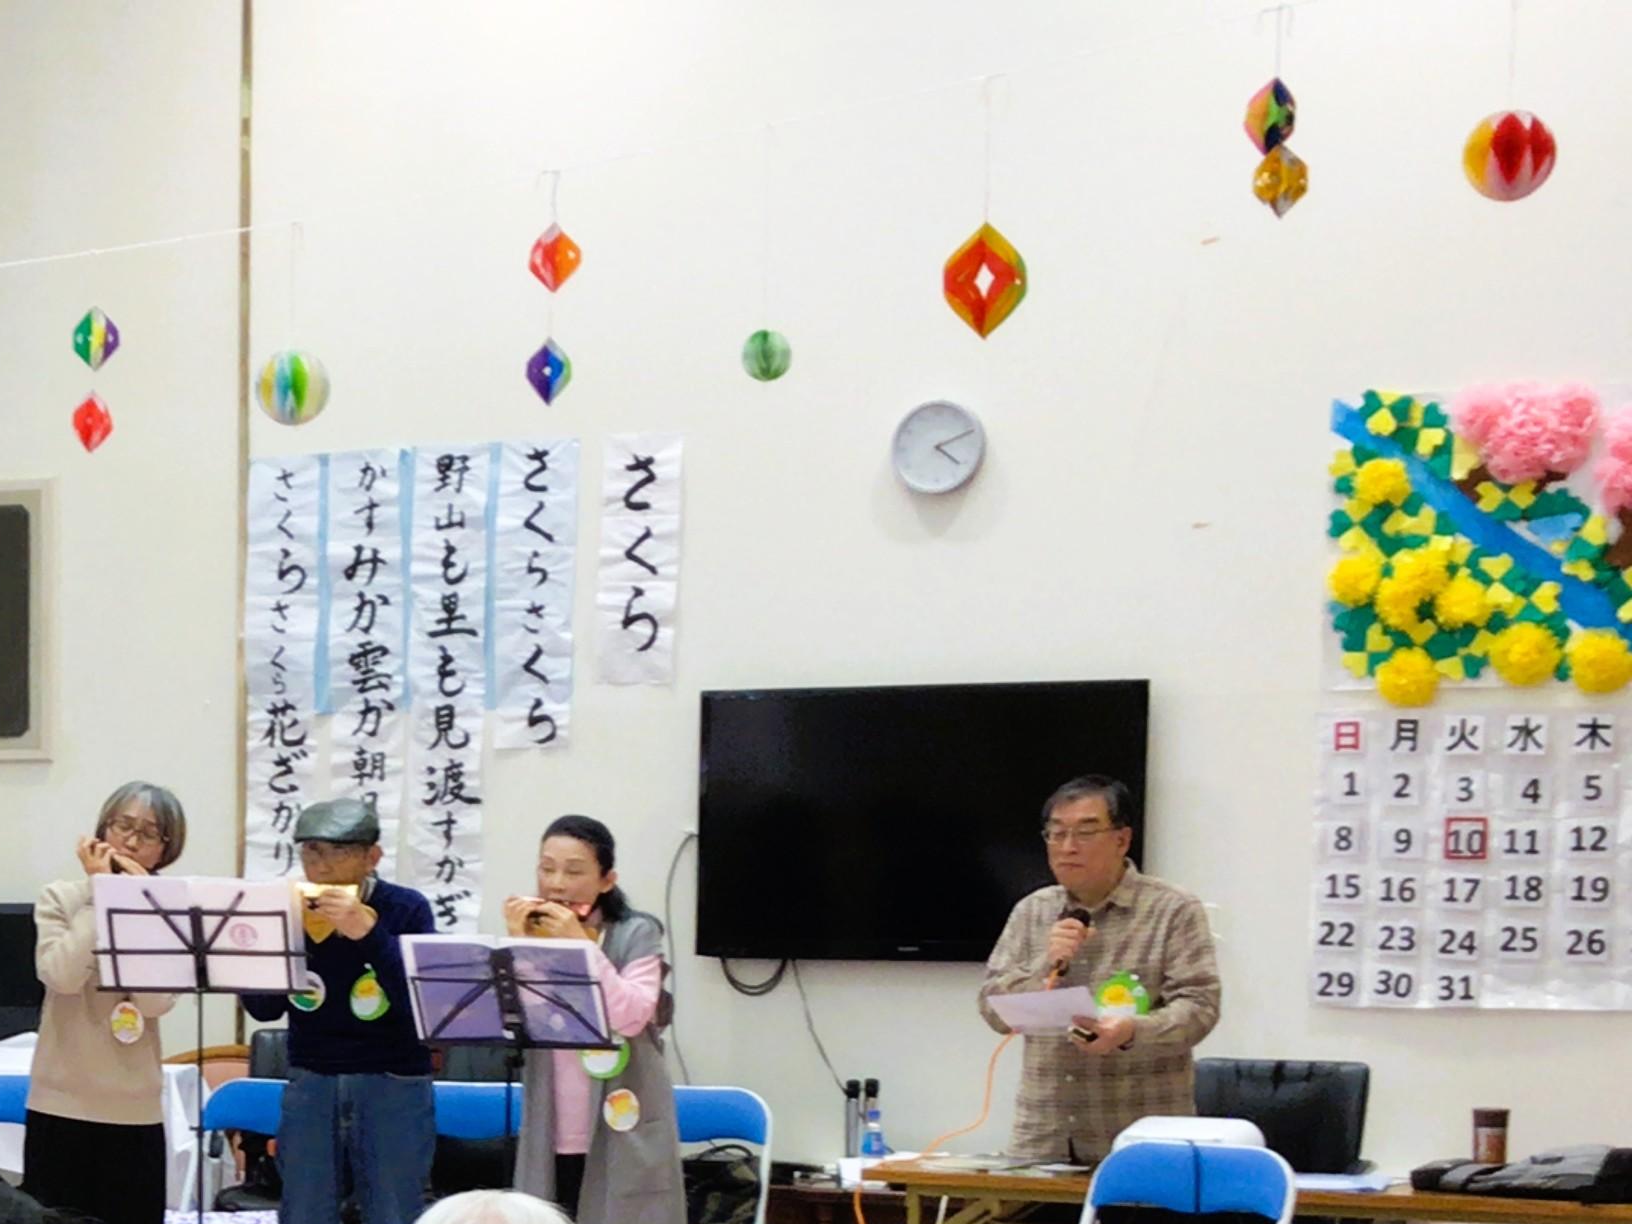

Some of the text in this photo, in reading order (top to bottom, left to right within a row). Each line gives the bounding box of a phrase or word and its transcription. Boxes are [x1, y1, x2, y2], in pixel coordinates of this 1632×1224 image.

[621, 454, 660, 653] さくら
[521, 447, 558, 745] さくらさくら
[259, 469, 309, 877] さくらさくら花ざかり
[1334, 717, 1613, 752] 日 月 火 水 木
[1343, 771, 1603, 804] 1 2 3 4 5
[1334, 825, 1608, 856] 8 9 10 11 12
[1325, 874, 1610, 904] 15 16 17 18 19
[1317, 921, 1607, 956] 22 23 24 25 26
[1317, 969, 1475, 1001] 29 30 31
